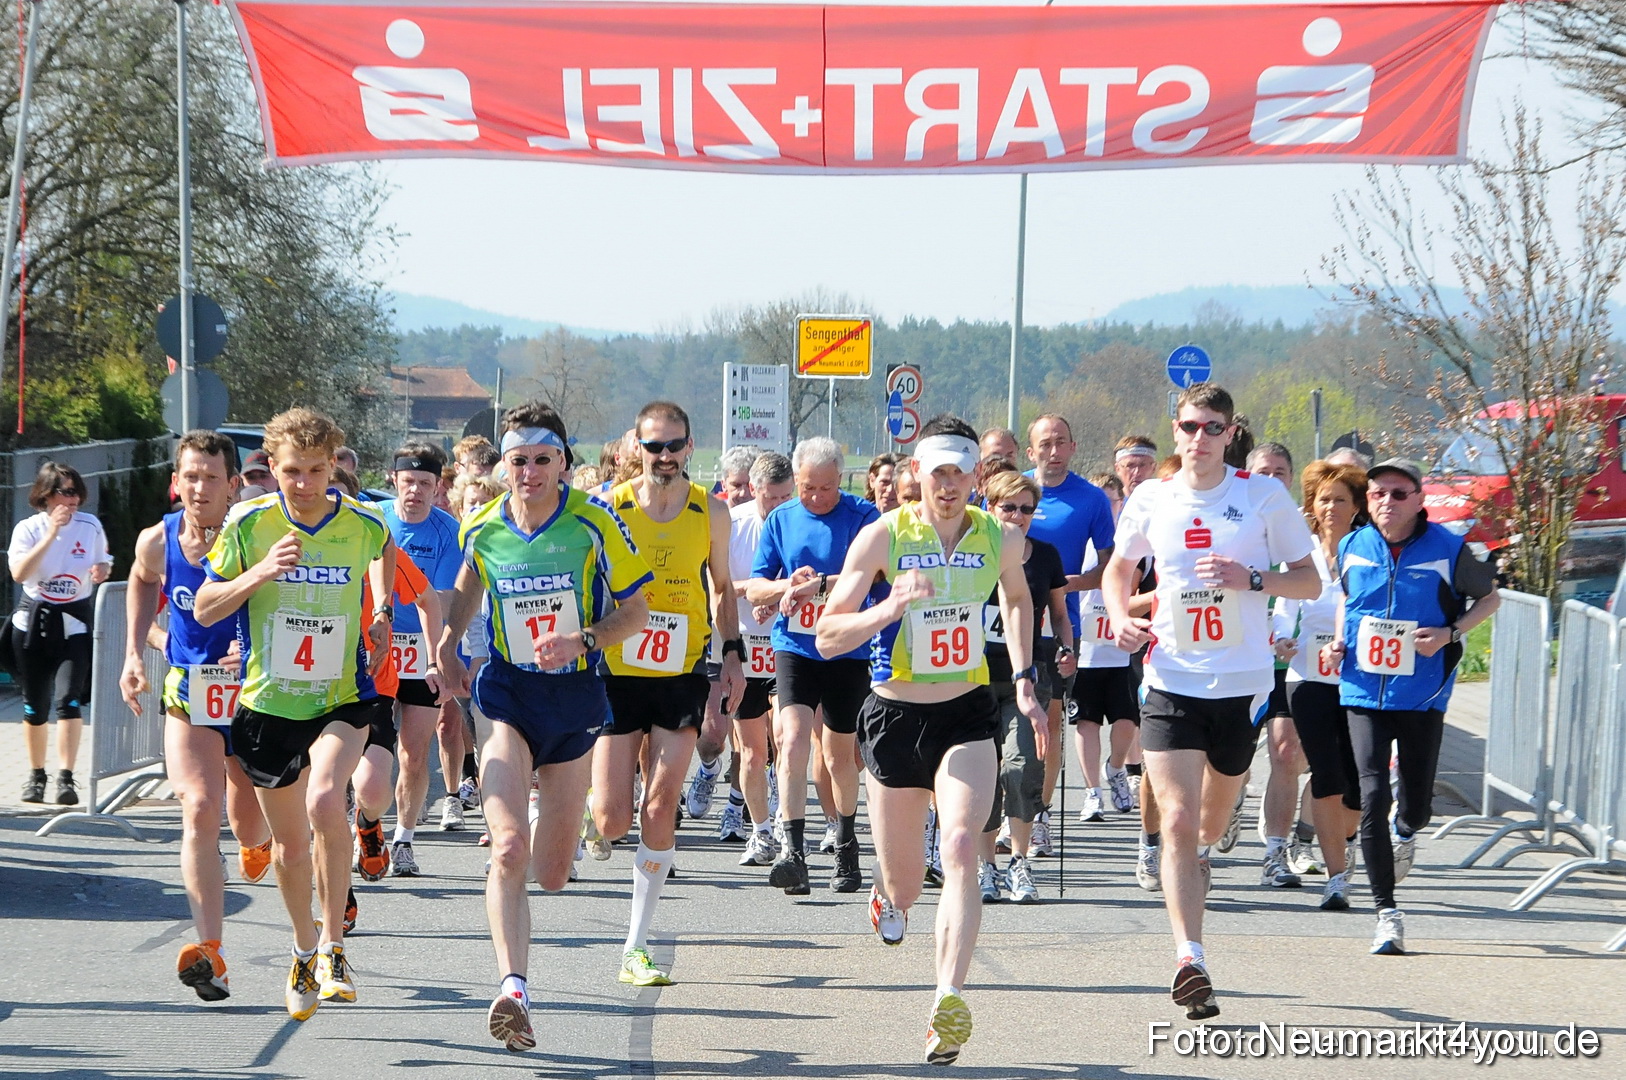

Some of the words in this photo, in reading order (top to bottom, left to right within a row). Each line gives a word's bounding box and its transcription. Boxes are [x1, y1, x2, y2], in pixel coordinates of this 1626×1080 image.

[805, 326, 864, 344] Sengenthal
[896, 377, 915, 394] 60
[738, 406, 751, 420] SHB
[497, 562, 529, 574] TEAM
[899, 551, 988, 571] BOCK
[494, 571, 577, 596] BOCK
[1180, 590, 1210, 600] MEYER
[514, 599, 549, 611] MEYER
[514, 604, 550, 616] WERBUNG
[923, 607, 958, 619] MEYER
[285, 617, 320, 628] MEYER
[651, 615, 667, 624] YER
[924, 614, 959, 625] WERBUNG
[1186, 606, 1225, 643] 76
[286, 625, 320, 635] WERBUNG
[526, 614, 557, 644] 17
[293, 635, 316, 672] 4
[636, 628, 672, 665] 78
[930, 626, 970, 669] 59
[1368, 636, 1402, 669] 83
[391, 646, 418, 674] 82
[751, 647, 777, 673] 53
[205, 685, 241, 720] 67
